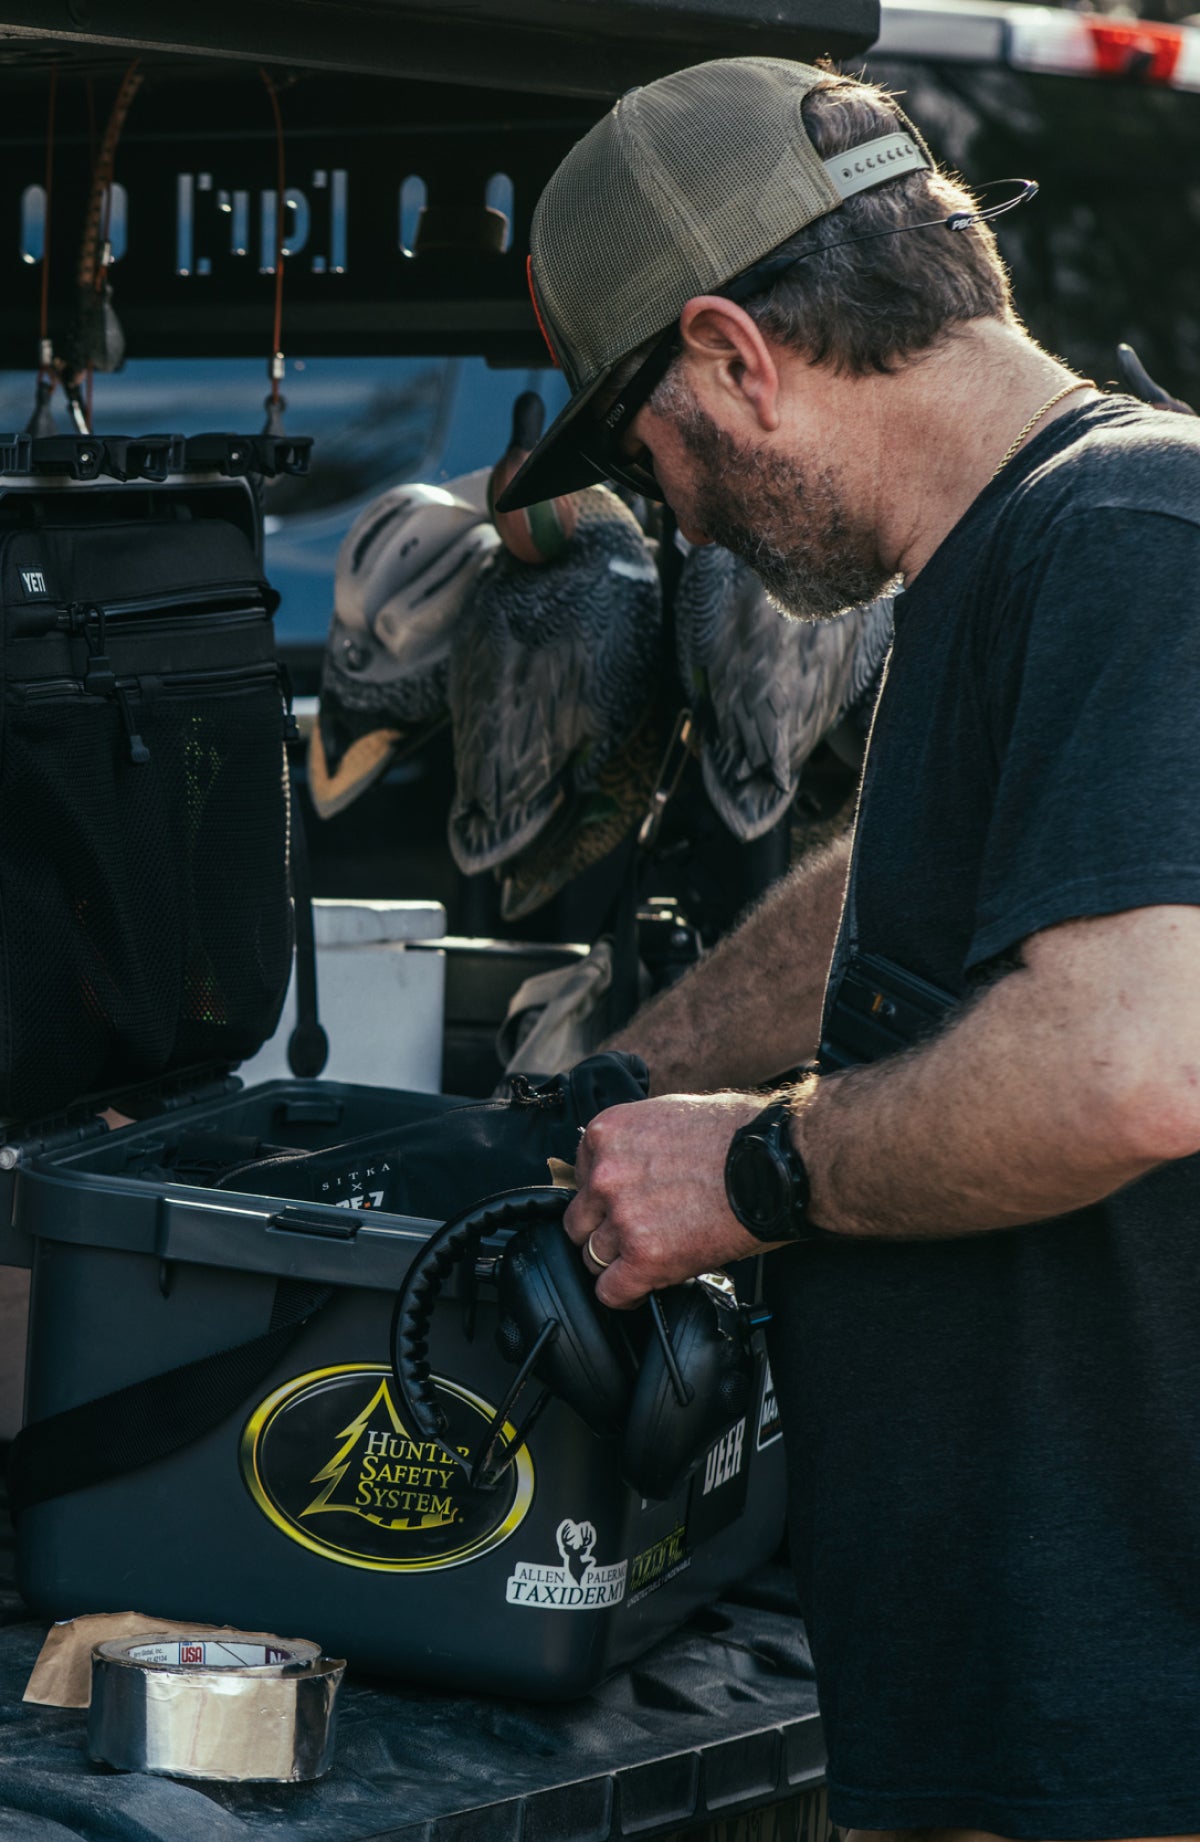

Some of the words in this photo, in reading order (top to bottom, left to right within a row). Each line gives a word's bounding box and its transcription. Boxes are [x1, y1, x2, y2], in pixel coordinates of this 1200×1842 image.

[22, 572, 47, 593] YETI
[321, 1163, 391, 1191] SITKA
[359, 1455, 455, 1489] SAFETY
[355, 1480, 453, 1516] SYSTEM
[519, 1568, 566, 1583] ALLEN
[512, 1579, 625, 1606] TAXIDERMY
[181, 1646, 203, 1663] USA
